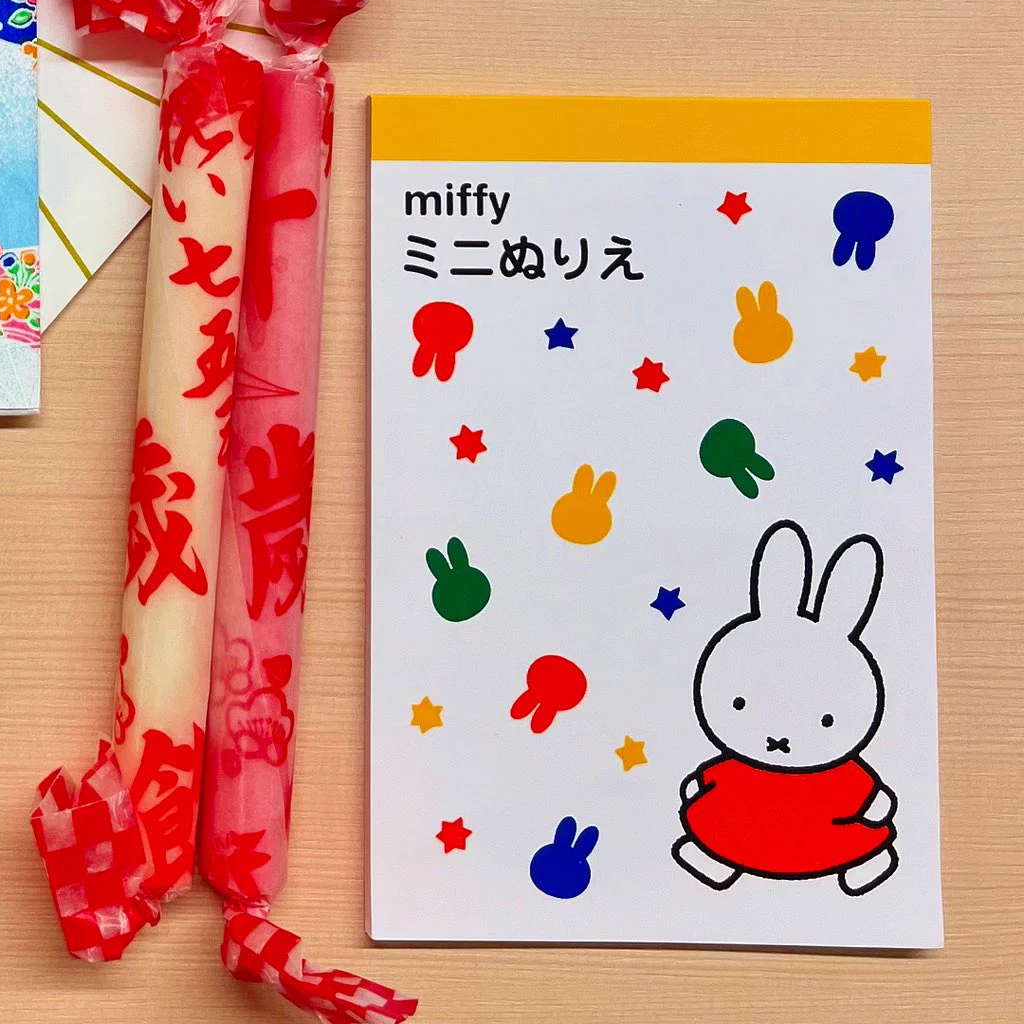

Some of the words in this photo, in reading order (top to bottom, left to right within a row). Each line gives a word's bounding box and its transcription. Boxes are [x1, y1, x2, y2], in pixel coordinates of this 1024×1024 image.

[404, 182, 511, 225] miffy
[403, 235, 645, 281] ミニぬりえ
